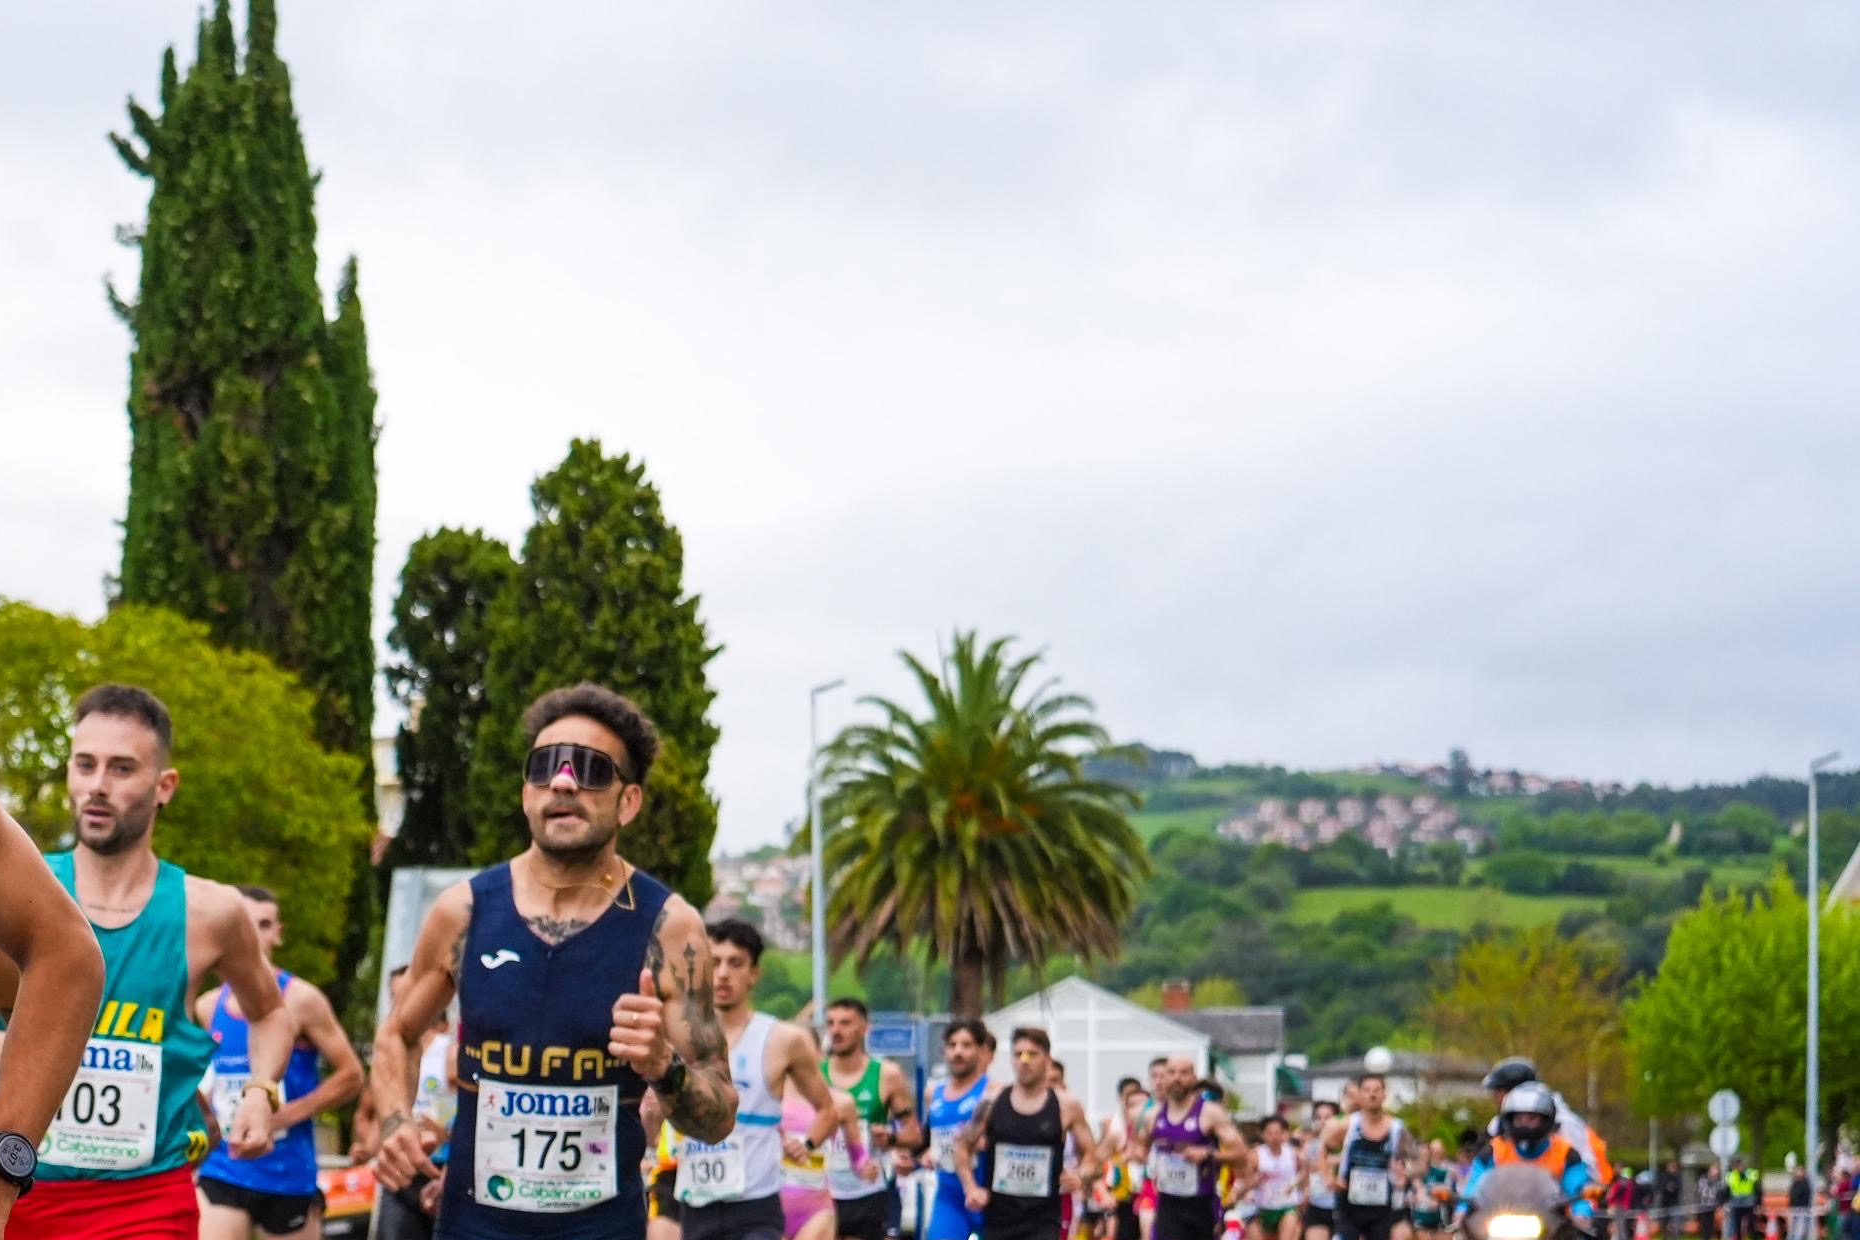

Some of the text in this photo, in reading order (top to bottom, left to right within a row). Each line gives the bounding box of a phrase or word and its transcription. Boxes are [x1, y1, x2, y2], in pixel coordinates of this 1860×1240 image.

[96, 1000, 165, 1043] ILA
[81, 1046, 134, 1072] ma
[511, 1128, 581, 1172] 175
[691, 1160, 725, 1184] 130
